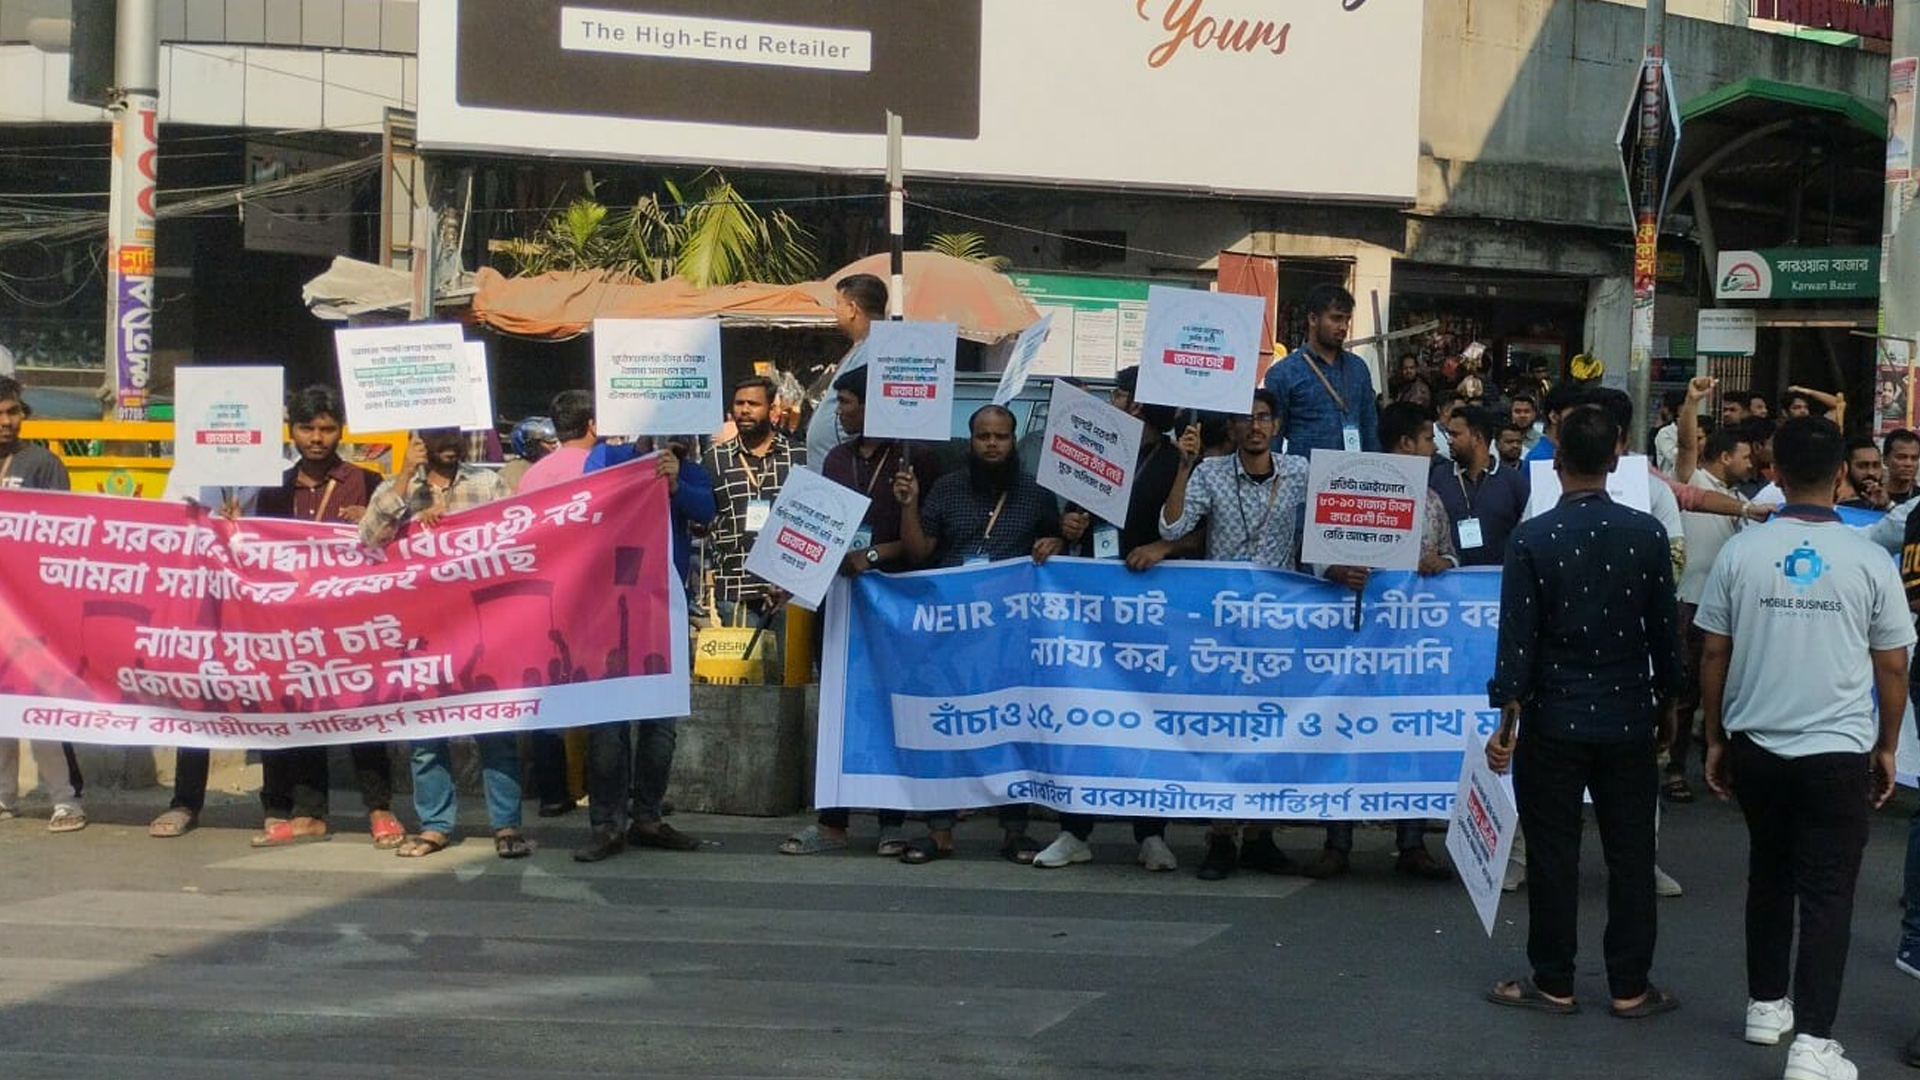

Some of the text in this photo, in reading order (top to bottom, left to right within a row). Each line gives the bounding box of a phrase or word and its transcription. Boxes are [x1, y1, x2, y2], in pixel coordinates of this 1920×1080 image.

[581, 21, 851, 59] The High-End Retailer
[1776, 257, 1869, 274] কারওয়ান বাজার
[1791, 280, 1858, 291] Karwan Bazar
[1174, 353, 1225, 369] জবাব চাই
[1330, 477, 1405, 494] প্রতিটা আইফোনে
[1320, 496, 1413, 513] ৮০-৯০ হাজার টাকা
[1330, 511, 1351, 523] করে
[0, 510, 96, 547] আমরা
[1323, 527, 1344, 540] রেডি
[1345, 530, 1377, 543] আছেন
[38, 555, 150, 595] আমরা
[430, 541, 537, 581] আছি
[806, 542, 824, 560] চাই
[912, 600, 996, 633] NEIR
[1003, 590, 1105, 624] সংস্কার
[1112, 589, 1168, 627] চাই
[1212, 590, 1364, 630] সিন্ডিকেট
[1373, 589, 1451, 630] নীতি
[1760, 597, 1843, 613] MOBILE BUSINESS
[134, 614, 418, 672] ন্যায্য সুযোগ চাই,
[1031, 635, 1453, 684] ন্যায্য কর, উন্মুক্ত আমদানি
[117, 654, 455, 706] একচেটিয়া নীতি নয়।
[22, 698, 543, 738] মোবাইল ব্যবসায়ীদের শান্তিপূর্ণ মানববন্ধন
[1027, 703, 1142, 734] ২৫,০০০
[1153, 702, 1287, 742] ব্যবসায়ী
[1297, 711, 1322, 738] ও
[1335, 712, 1379, 740] ২০
[1390, 708, 1465, 738] লাখ
[1007, 779, 1074, 806] মোবাইল
[1080, 784, 1237, 813] ব্যবসায়ীদের
[1244, 787, 1353, 818] শান্তিপূর্ণ
